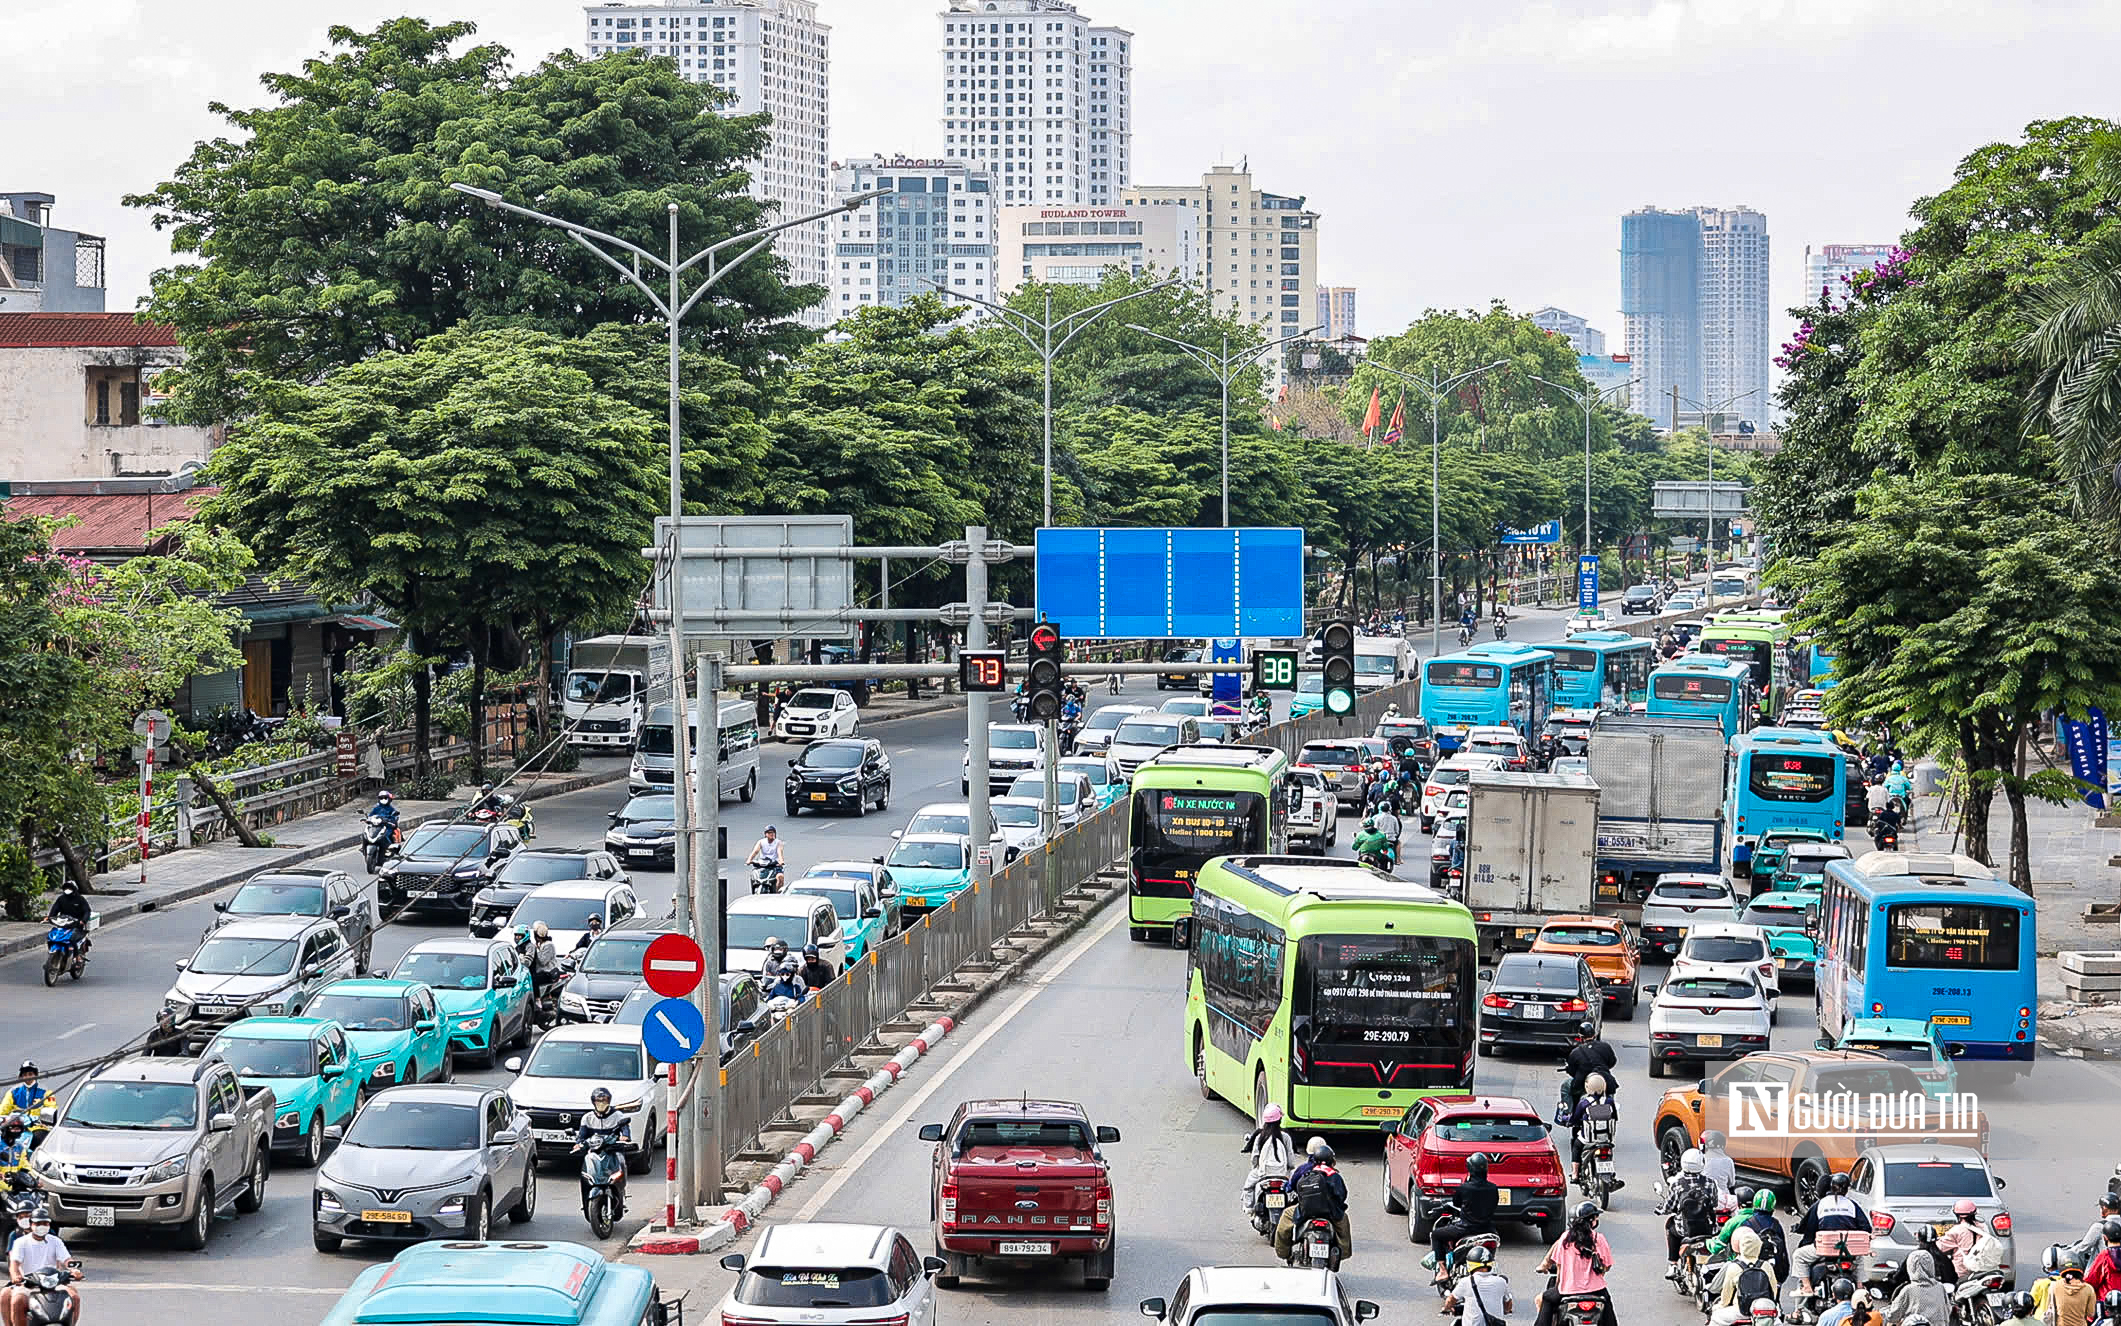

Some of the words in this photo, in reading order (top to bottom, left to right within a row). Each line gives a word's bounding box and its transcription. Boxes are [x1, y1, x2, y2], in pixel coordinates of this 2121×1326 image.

[1040, 209, 1088, 219] HUDLAND
[1090, 209, 1127, 218] TOWER
[971, 659, 999, 684] 73
[1263, 657, 1292, 683] 38
[2092, 716, 2103, 765] VINFAST
[2071, 725, 2091, 776] VINFAST
[1186, 800, 1197, 809] XE
[1198, 798, 1224, 810] NƯỚC
[1332, 987, 1346, 996] 0917
[1346, 988, 1357, 997] 601
[1363, 1030, 1410, 1042] 29E-290.79
[961, 1214, 1092, 1225] RANGER
